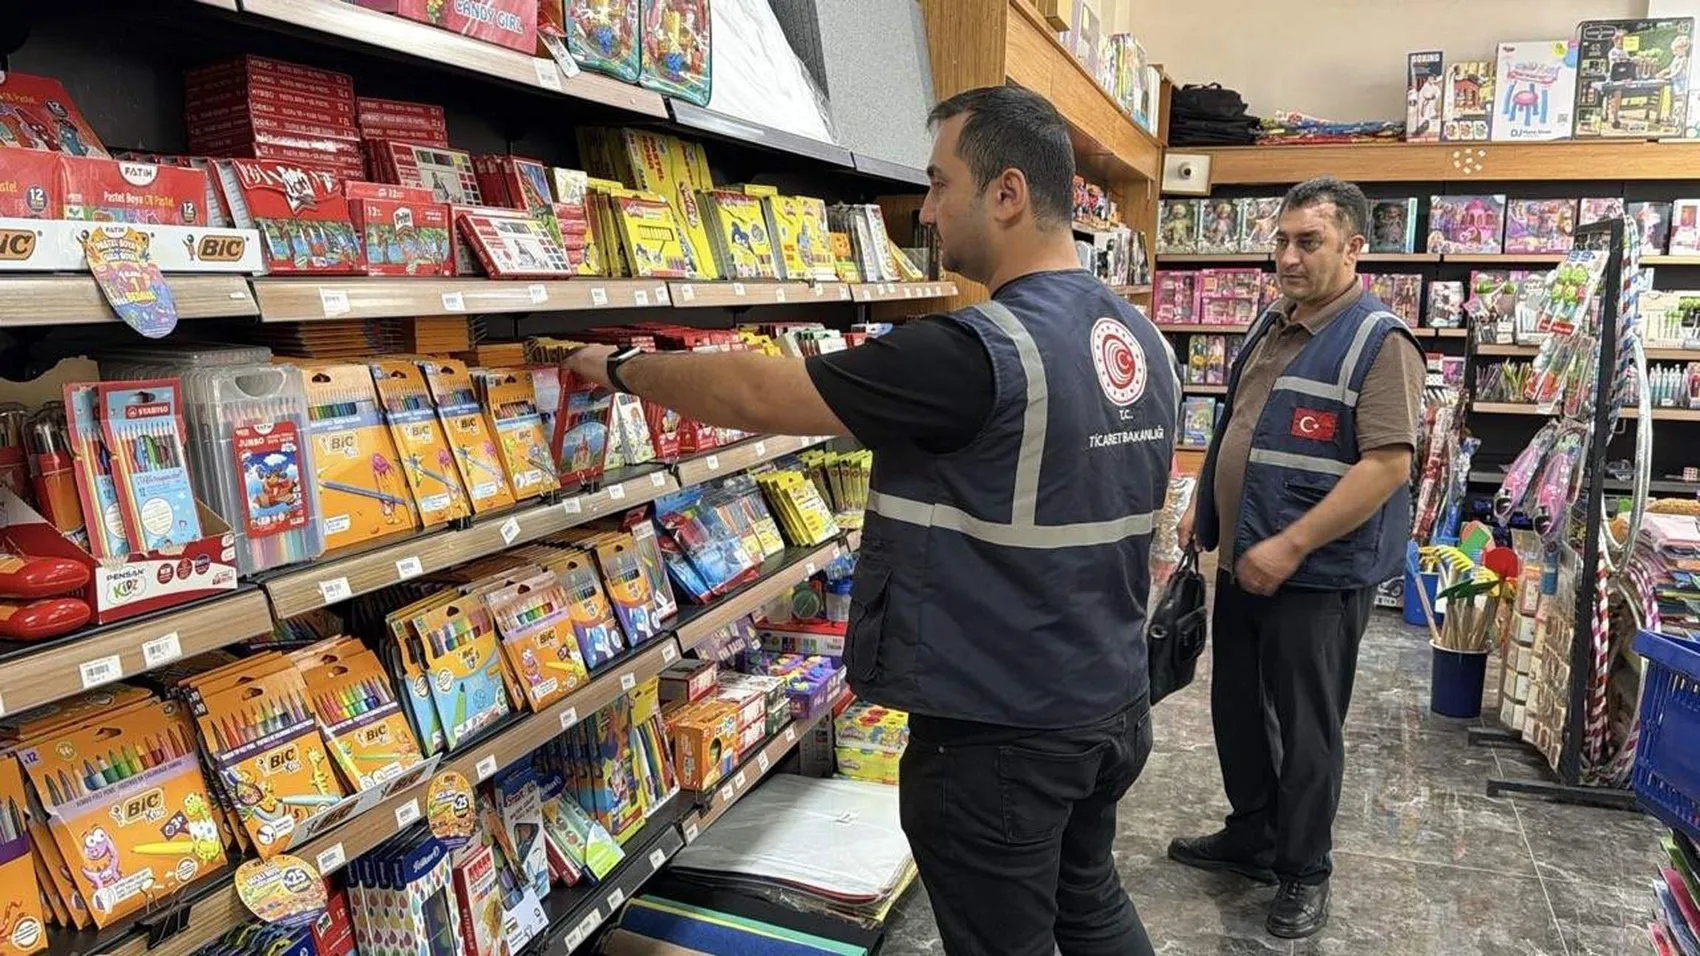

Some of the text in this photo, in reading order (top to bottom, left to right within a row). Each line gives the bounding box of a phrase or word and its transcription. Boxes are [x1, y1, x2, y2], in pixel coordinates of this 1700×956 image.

[455, 0, 524, 34] CANDY GIRL
[29, 188, 44, 201] 12
[184, 202, 194, 213] 12
[106, 569, 145, 582] PENSAN
